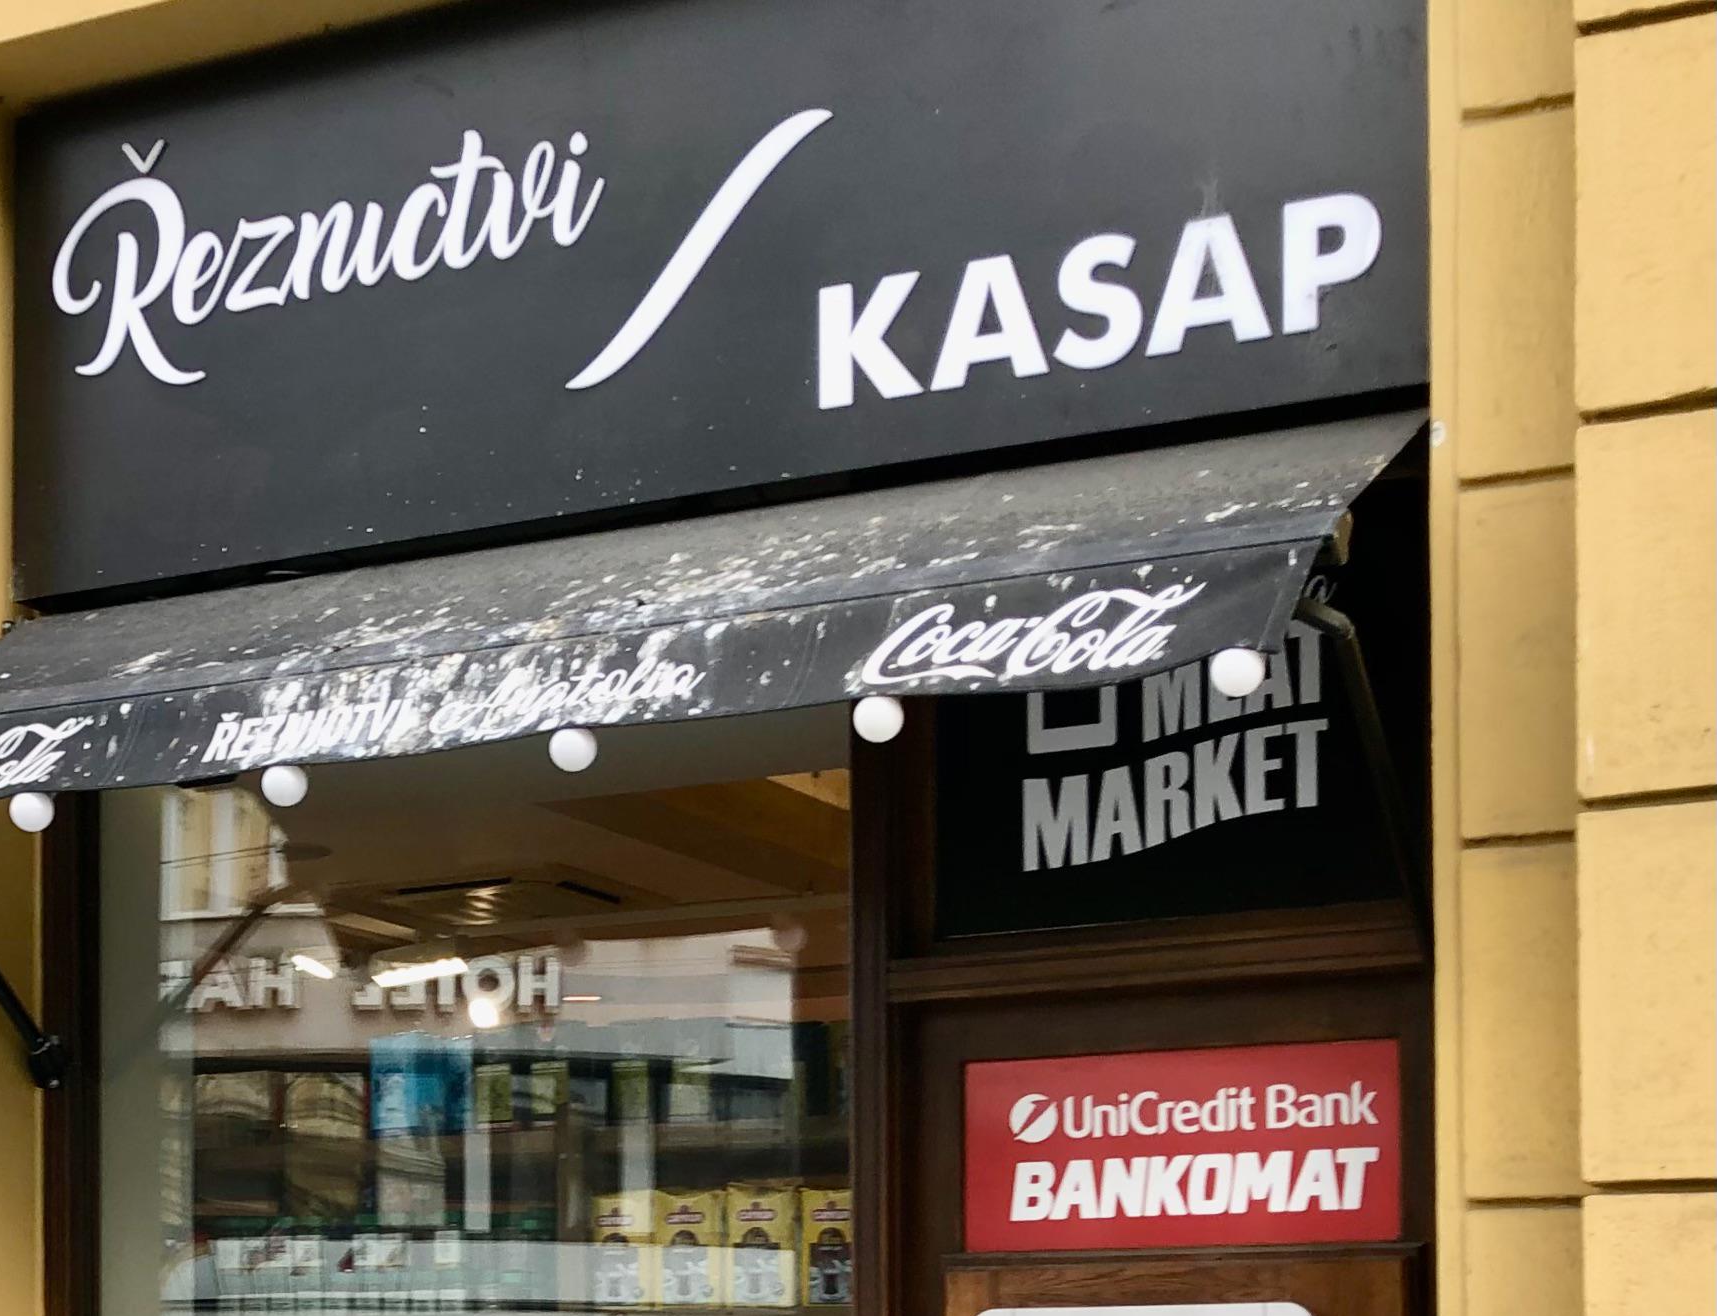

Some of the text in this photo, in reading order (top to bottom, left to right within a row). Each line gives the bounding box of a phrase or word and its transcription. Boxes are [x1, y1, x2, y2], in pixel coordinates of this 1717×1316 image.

[817, 191, 1383, 411] KASAP
[861, 581, 1208, 685] Coca-Cola
[1022, 718, 1329, 873] MARKET
[1063, 1081, 1379, 1140] UniCredit Bank
[1009, 1146, 1380, 1223] BANKOMAT
